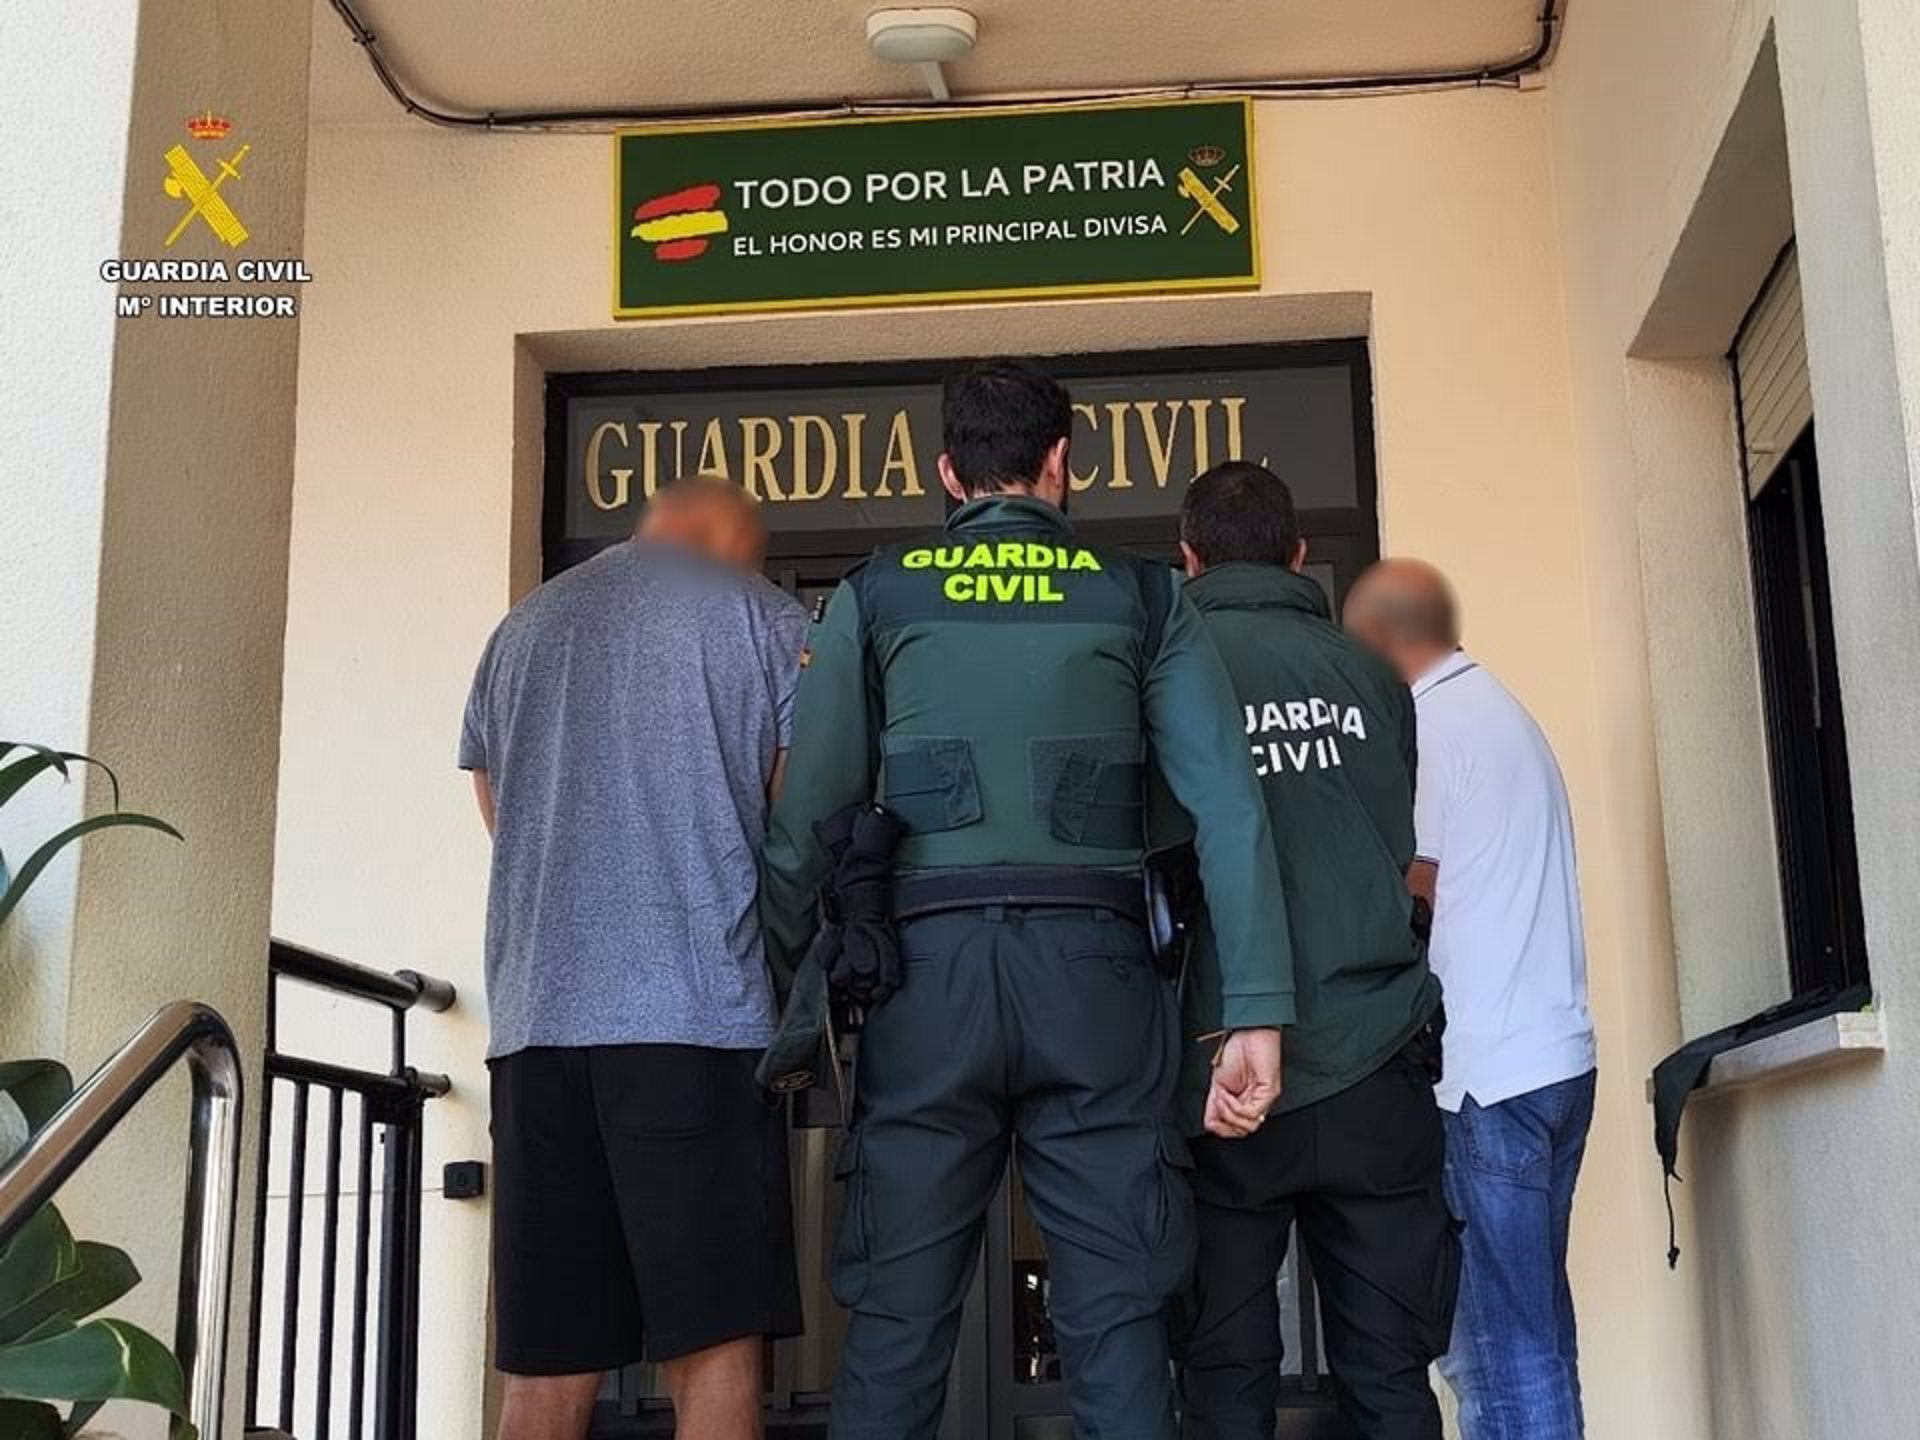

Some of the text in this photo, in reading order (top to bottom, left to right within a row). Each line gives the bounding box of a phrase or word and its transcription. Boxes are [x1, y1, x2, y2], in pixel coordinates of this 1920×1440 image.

[733, 158, 1165, 209] TODO POR LA PATRIA
[733, 214, 1168, 256] EL HONOR ES MI PRINCIPAL DIVISA
[585, 409, 926, 511] GUARDIA
[902, 543, 1101, 571] GUARDIA
[944, 574, 1064, 602] CIVIL
